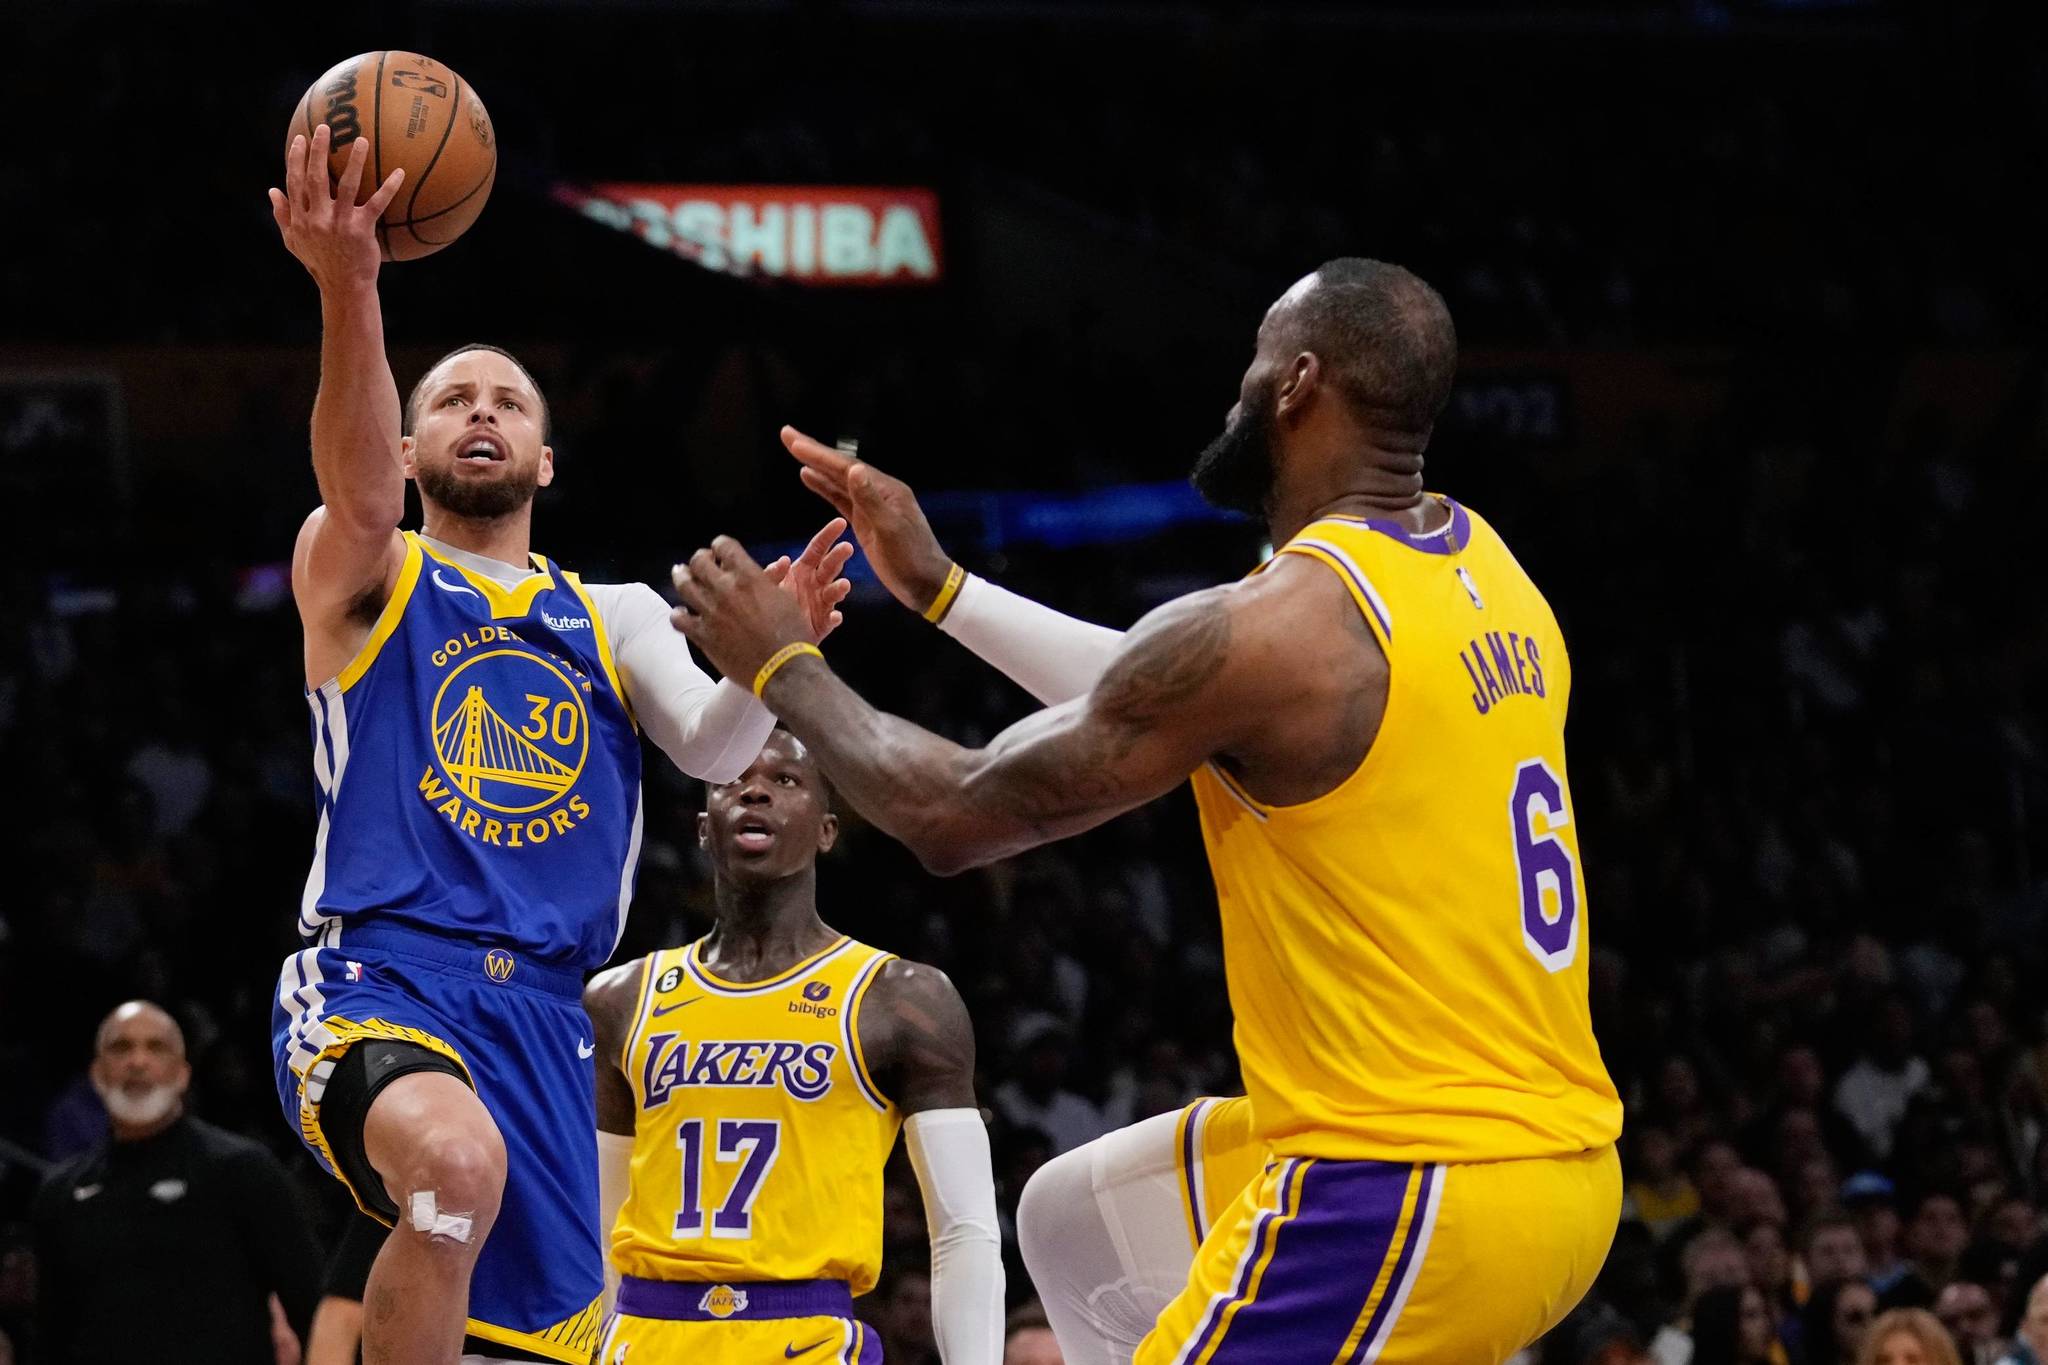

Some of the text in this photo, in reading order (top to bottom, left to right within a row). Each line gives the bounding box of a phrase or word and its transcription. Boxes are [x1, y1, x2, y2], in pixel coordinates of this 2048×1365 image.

[580, 200, 938, 278] SHIBA
[541, 610, 591, 631] kuten
[1460, 631, 1545, 715] JAMES
[521, 694, 579, 746] 30
[418, 765, 591, 847] WARRIORS
[1508, 756, 1577, 974] 6
[486, 954, 515, 979] W
[661, 968, 679, 993] 6
[788, 1001, 837, 1019] bibigo
[643, 1031, 837, 1113] LAKERS
[672, 1118, 781, 1239] 17
